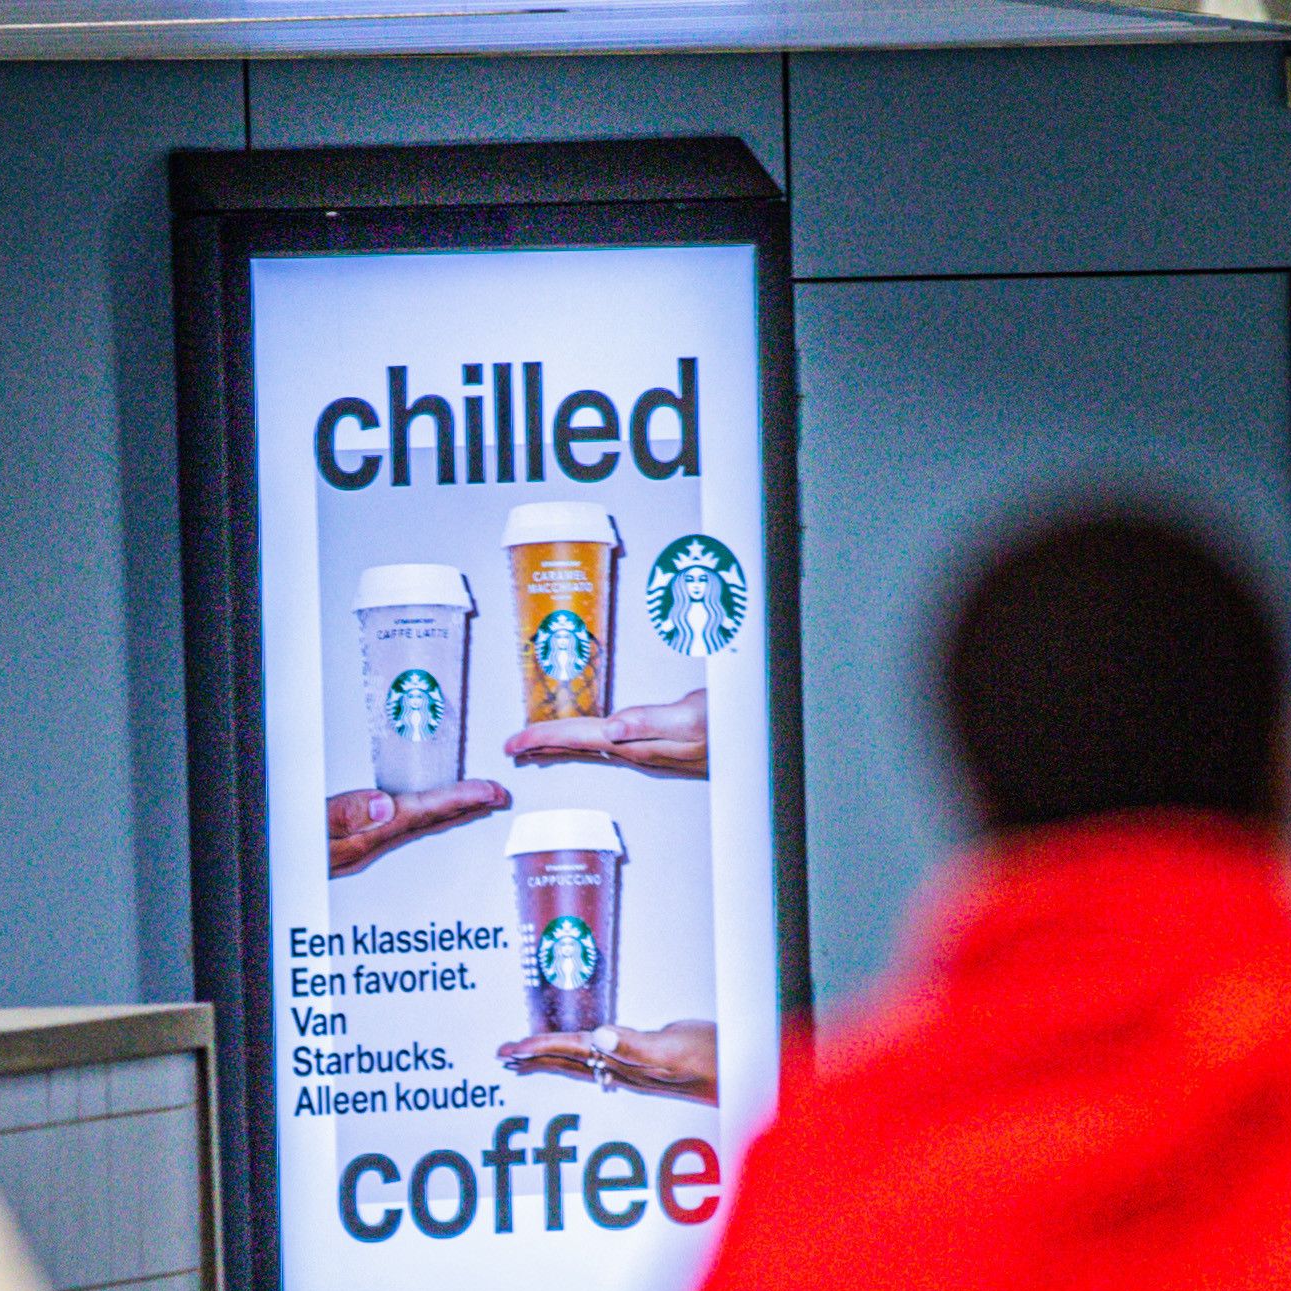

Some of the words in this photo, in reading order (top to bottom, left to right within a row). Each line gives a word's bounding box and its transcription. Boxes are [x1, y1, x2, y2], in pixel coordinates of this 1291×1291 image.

[314, 357, 701, 491] chilled
[290, 928, 344, 958] Een
[353, 921, 508, 955] klassieker.
[291, 967, 345, 997] Een
[353, 961, 476, 994] favoriet.
[291, 1006, 347, 1037] Van
[293, 1041, 454, 1077] Starbucks.
[294, 1085, 387, 1117] Alleen
[395, 1078, 505, 1112] kouder.
[338, 1113, 721, 1243] coffee
